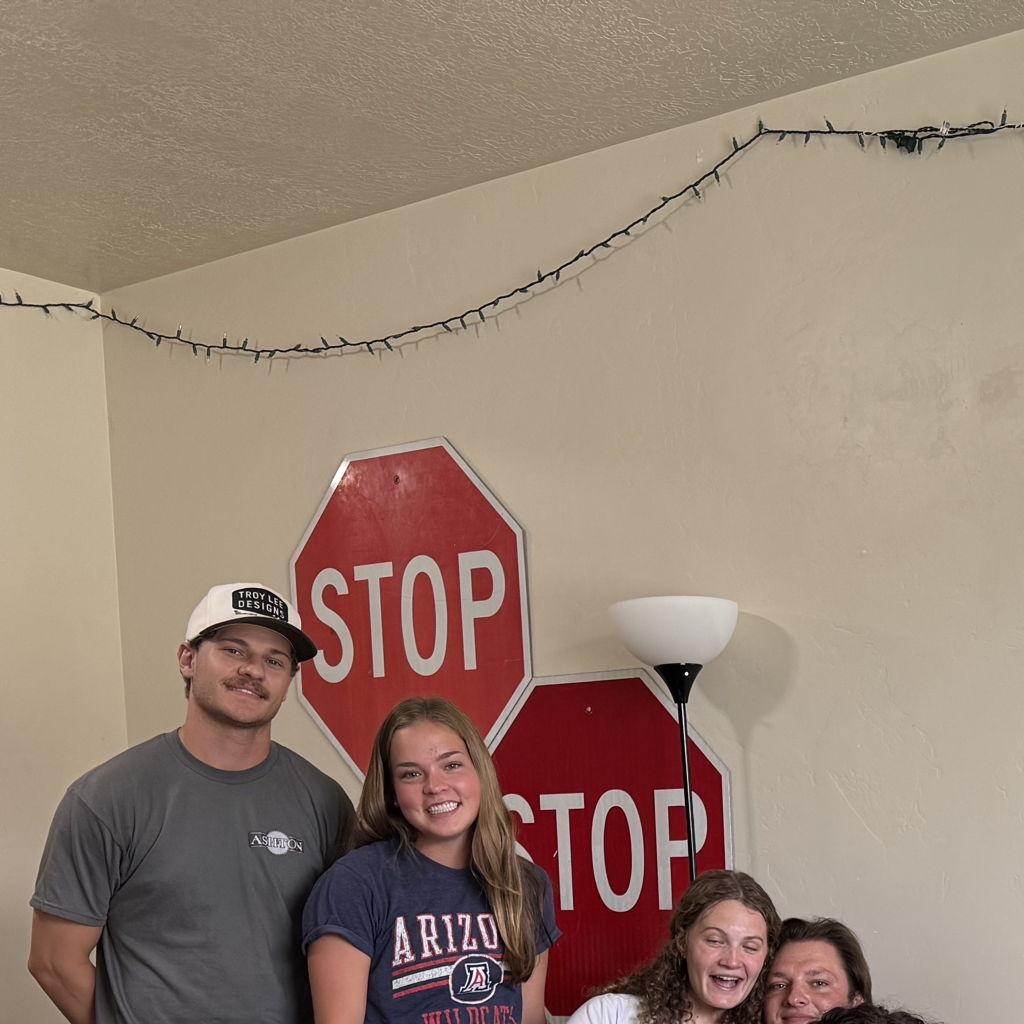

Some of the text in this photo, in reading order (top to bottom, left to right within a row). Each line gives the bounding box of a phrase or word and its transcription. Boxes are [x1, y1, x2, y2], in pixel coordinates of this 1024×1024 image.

[238, 591, 284, 609] TROY LEE
[238, 600, 285, 619] DESIGNS
[311, 550, 506, 684] STOP
